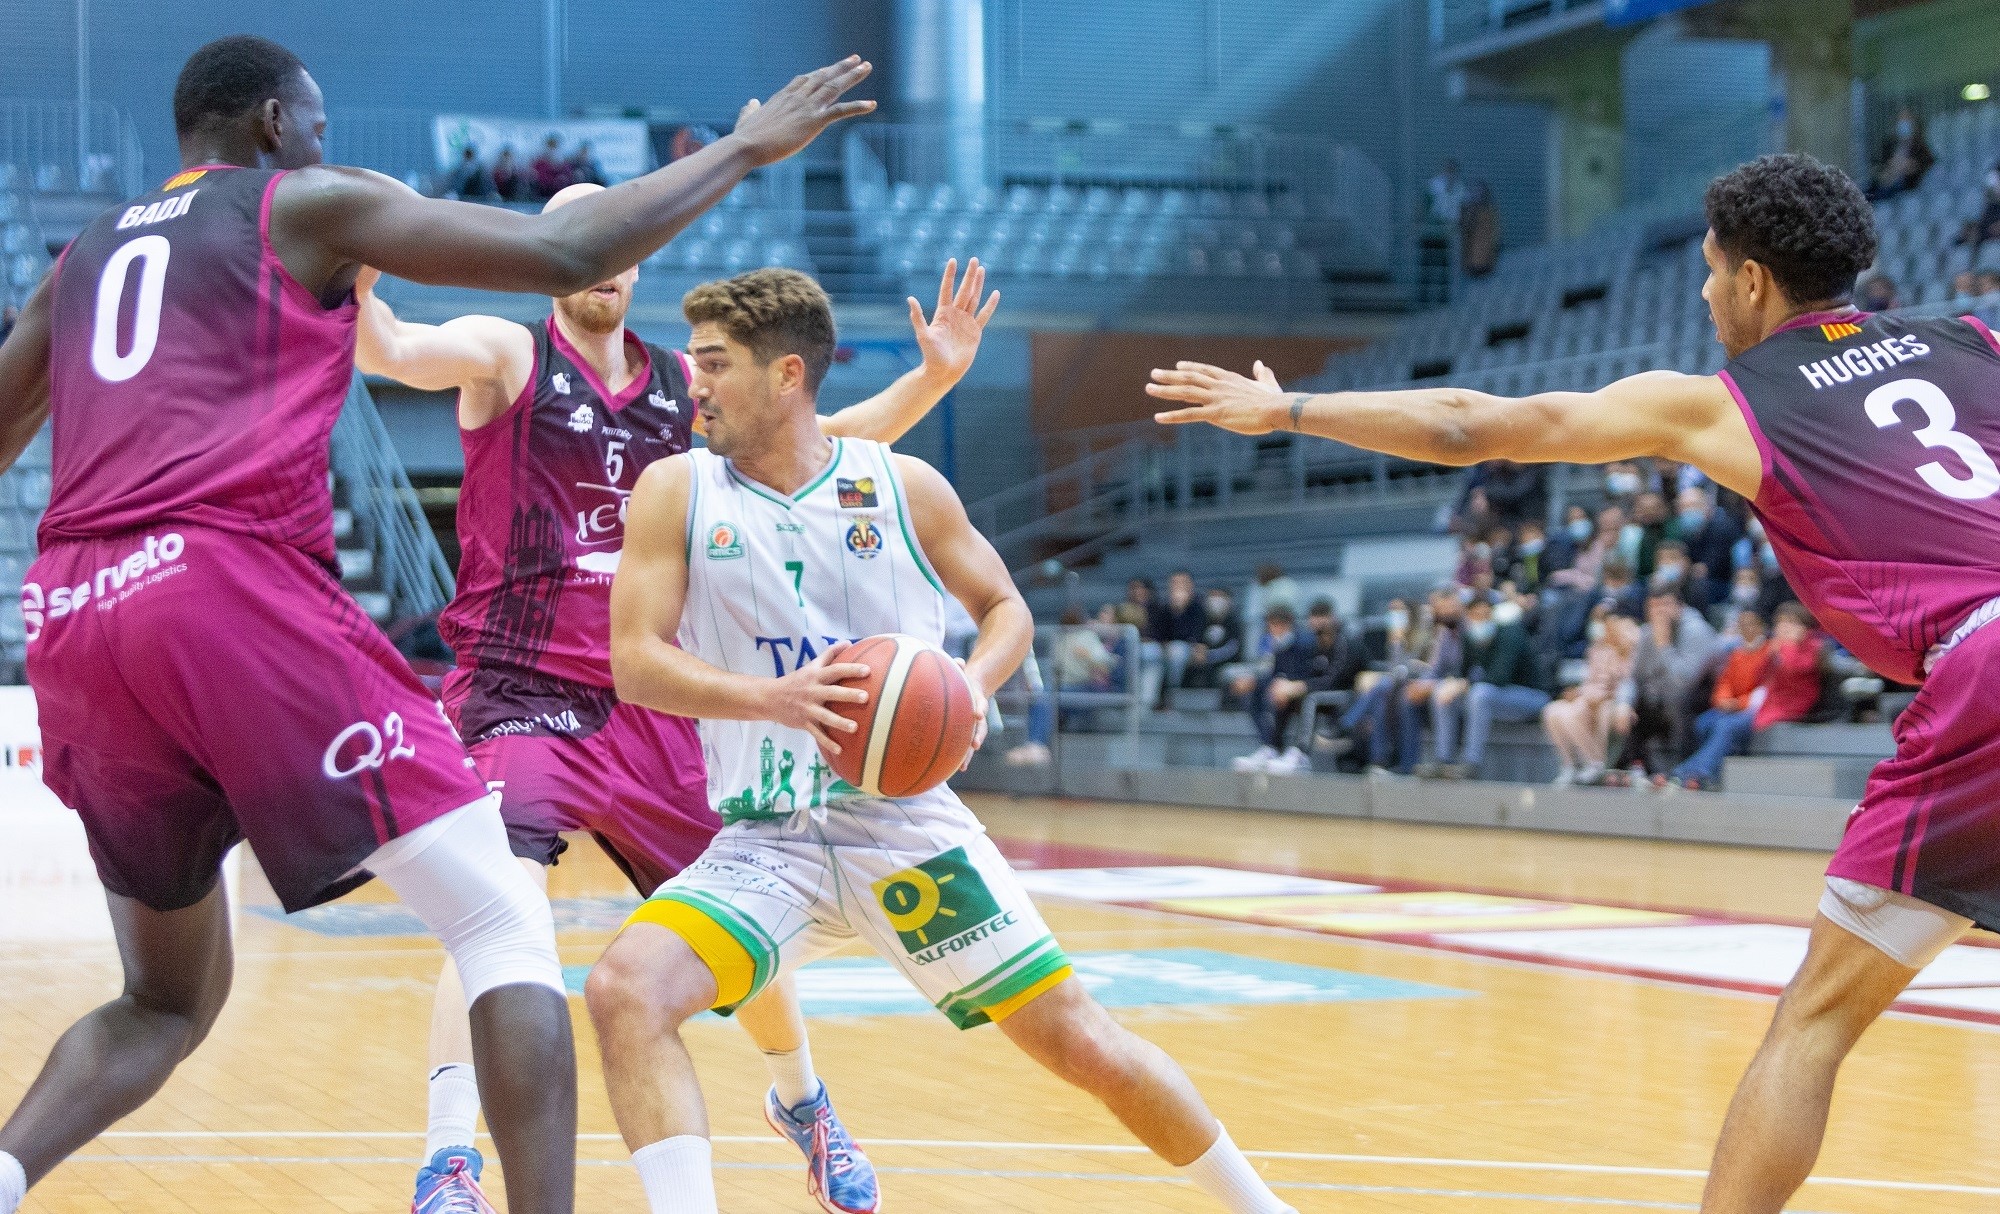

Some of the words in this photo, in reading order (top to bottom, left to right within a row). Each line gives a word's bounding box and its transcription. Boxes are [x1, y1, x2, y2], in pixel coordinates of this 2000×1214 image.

[116, 188, 200, 230] BADJI
[91, 234, 171, 382] 0
[1798, 334, 1931, 390] HUGHES
[606, 440, 626, 484] 5
[1864, 378, 2000, 499] 3
[578, 496, 630, 539] IC
[49, 532, 185, 618] serveto
[97, 596, 118, 612] High
[119, 582, 145, 601] Quality
[146, 562, 188, 584] Logistics
[785, 561, 804, 608] 7
[323, 711, 416, 778] Q2
